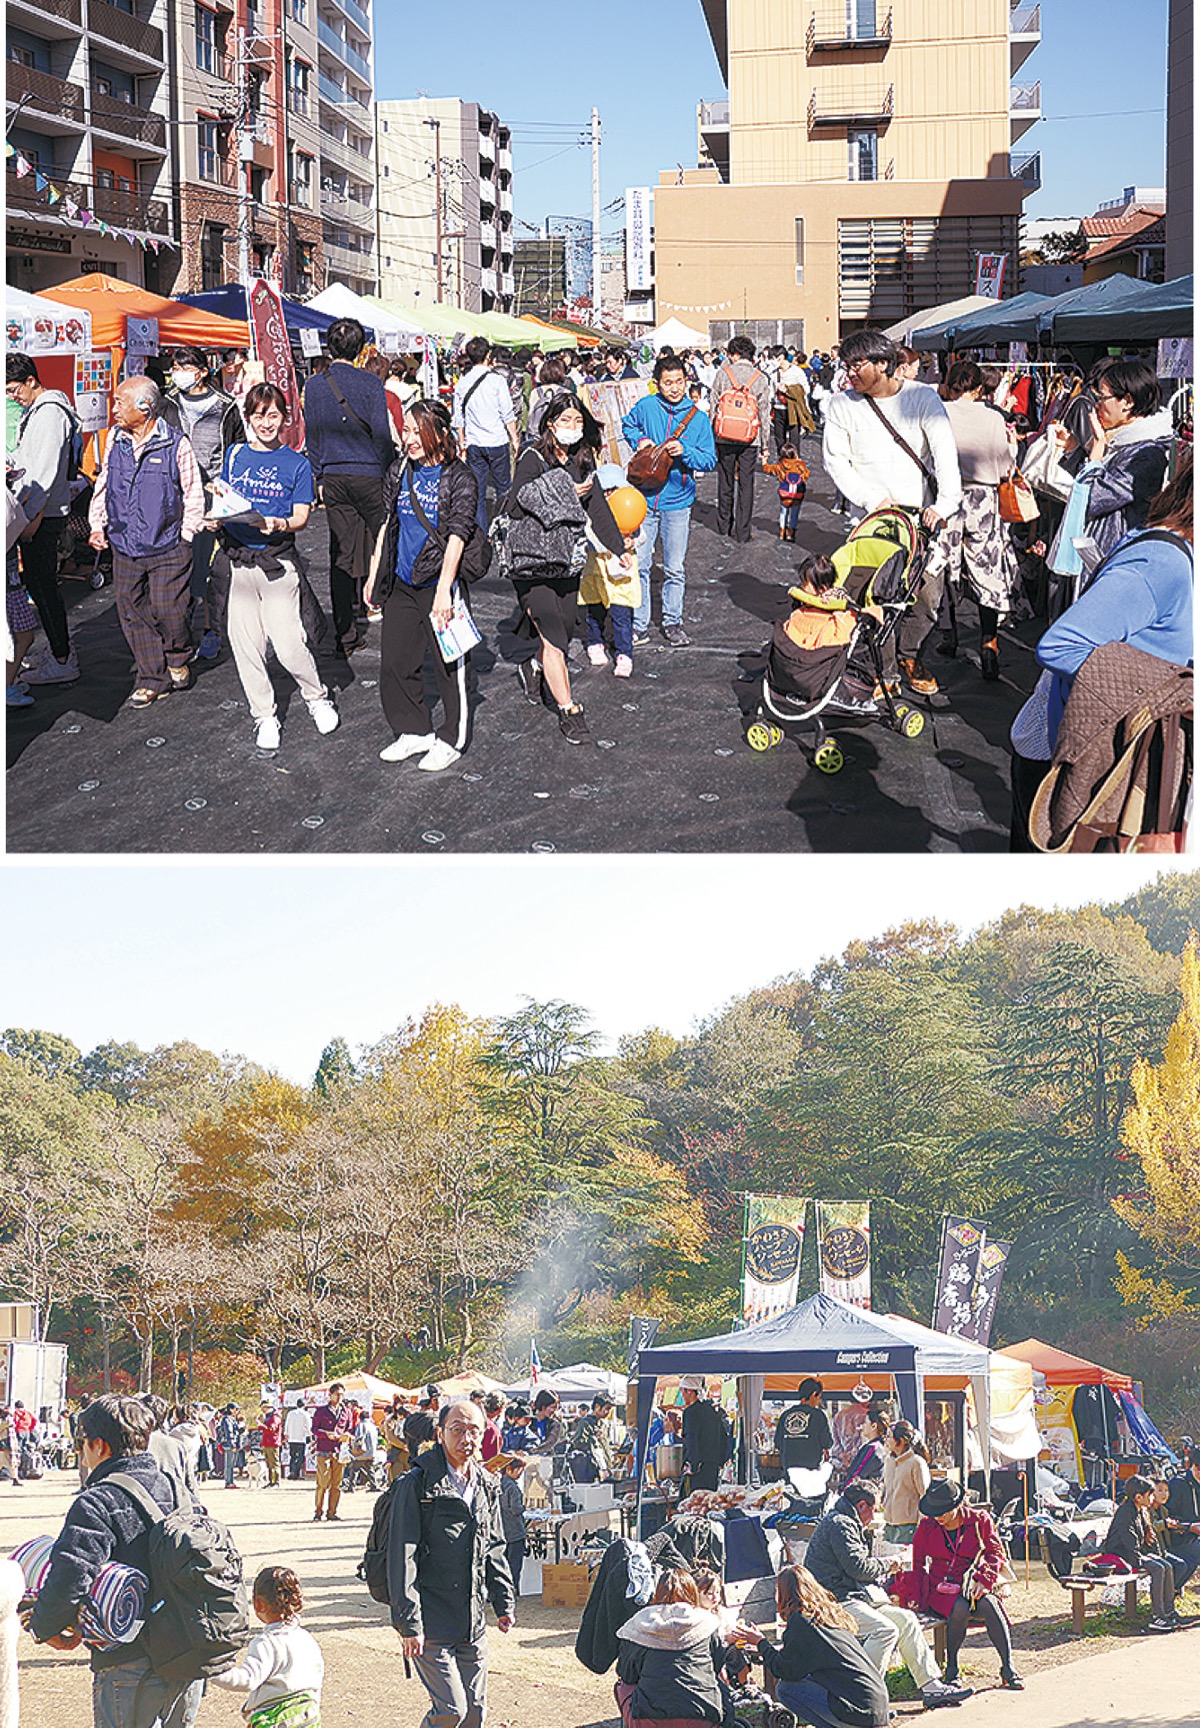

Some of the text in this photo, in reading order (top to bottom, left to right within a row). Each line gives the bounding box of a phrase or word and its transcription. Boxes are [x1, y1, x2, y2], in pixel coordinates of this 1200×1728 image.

[750, 1228, 790, 1246] かわさき
[825, 1229, 857, 1246] かわさき
[828, 1238, 855, 1253] ハーブ
[753, 1239, 786, 1253] ハーブ
[757, 1241, 799, 1263] ソーセージ
[829, 1241, 866, 1261] ソーセージ
